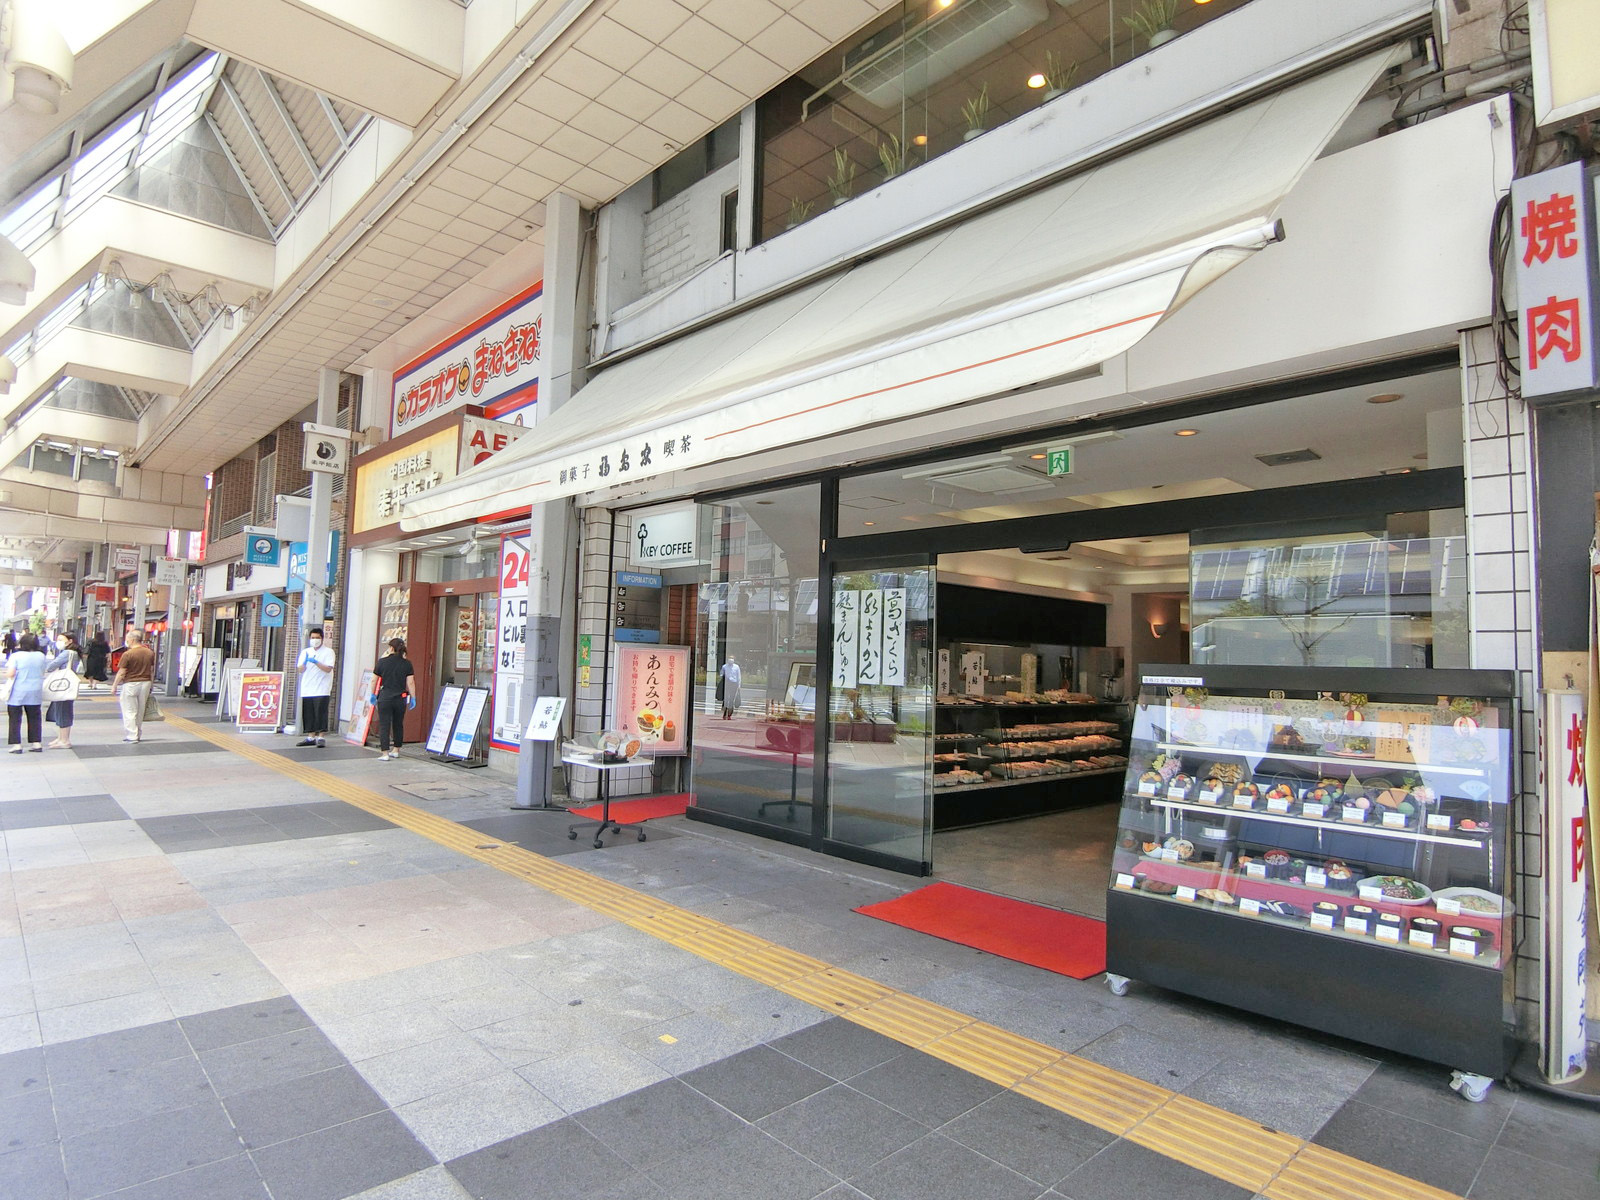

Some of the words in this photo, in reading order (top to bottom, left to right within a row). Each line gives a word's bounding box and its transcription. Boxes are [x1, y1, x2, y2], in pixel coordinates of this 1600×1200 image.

[1521, 193, 1581, 370] 焼肉
[406, 364, 460, 421] カラオケ
[470, 429, 519, 451] AE
[390, 450, 431, 481] 中国料理
[559, 463, 591, 486] 御菓子
[663, 434, 692, 458] 喫茶
[642, 544, 659, 558] KEY
[659, 541, 693, 557] COFFEE
[622, 575, 657, 585] INFORMATION
[618, 587, 626, 596] 4F
[617, 602, 625, 611] 3F
[616, 617, 624, 626] 2F
[630, 654, 639, 711] お持ち帰りできます
[645, 653, 661, 710] あんみつ
[248, 709, 272, 719] OFF
